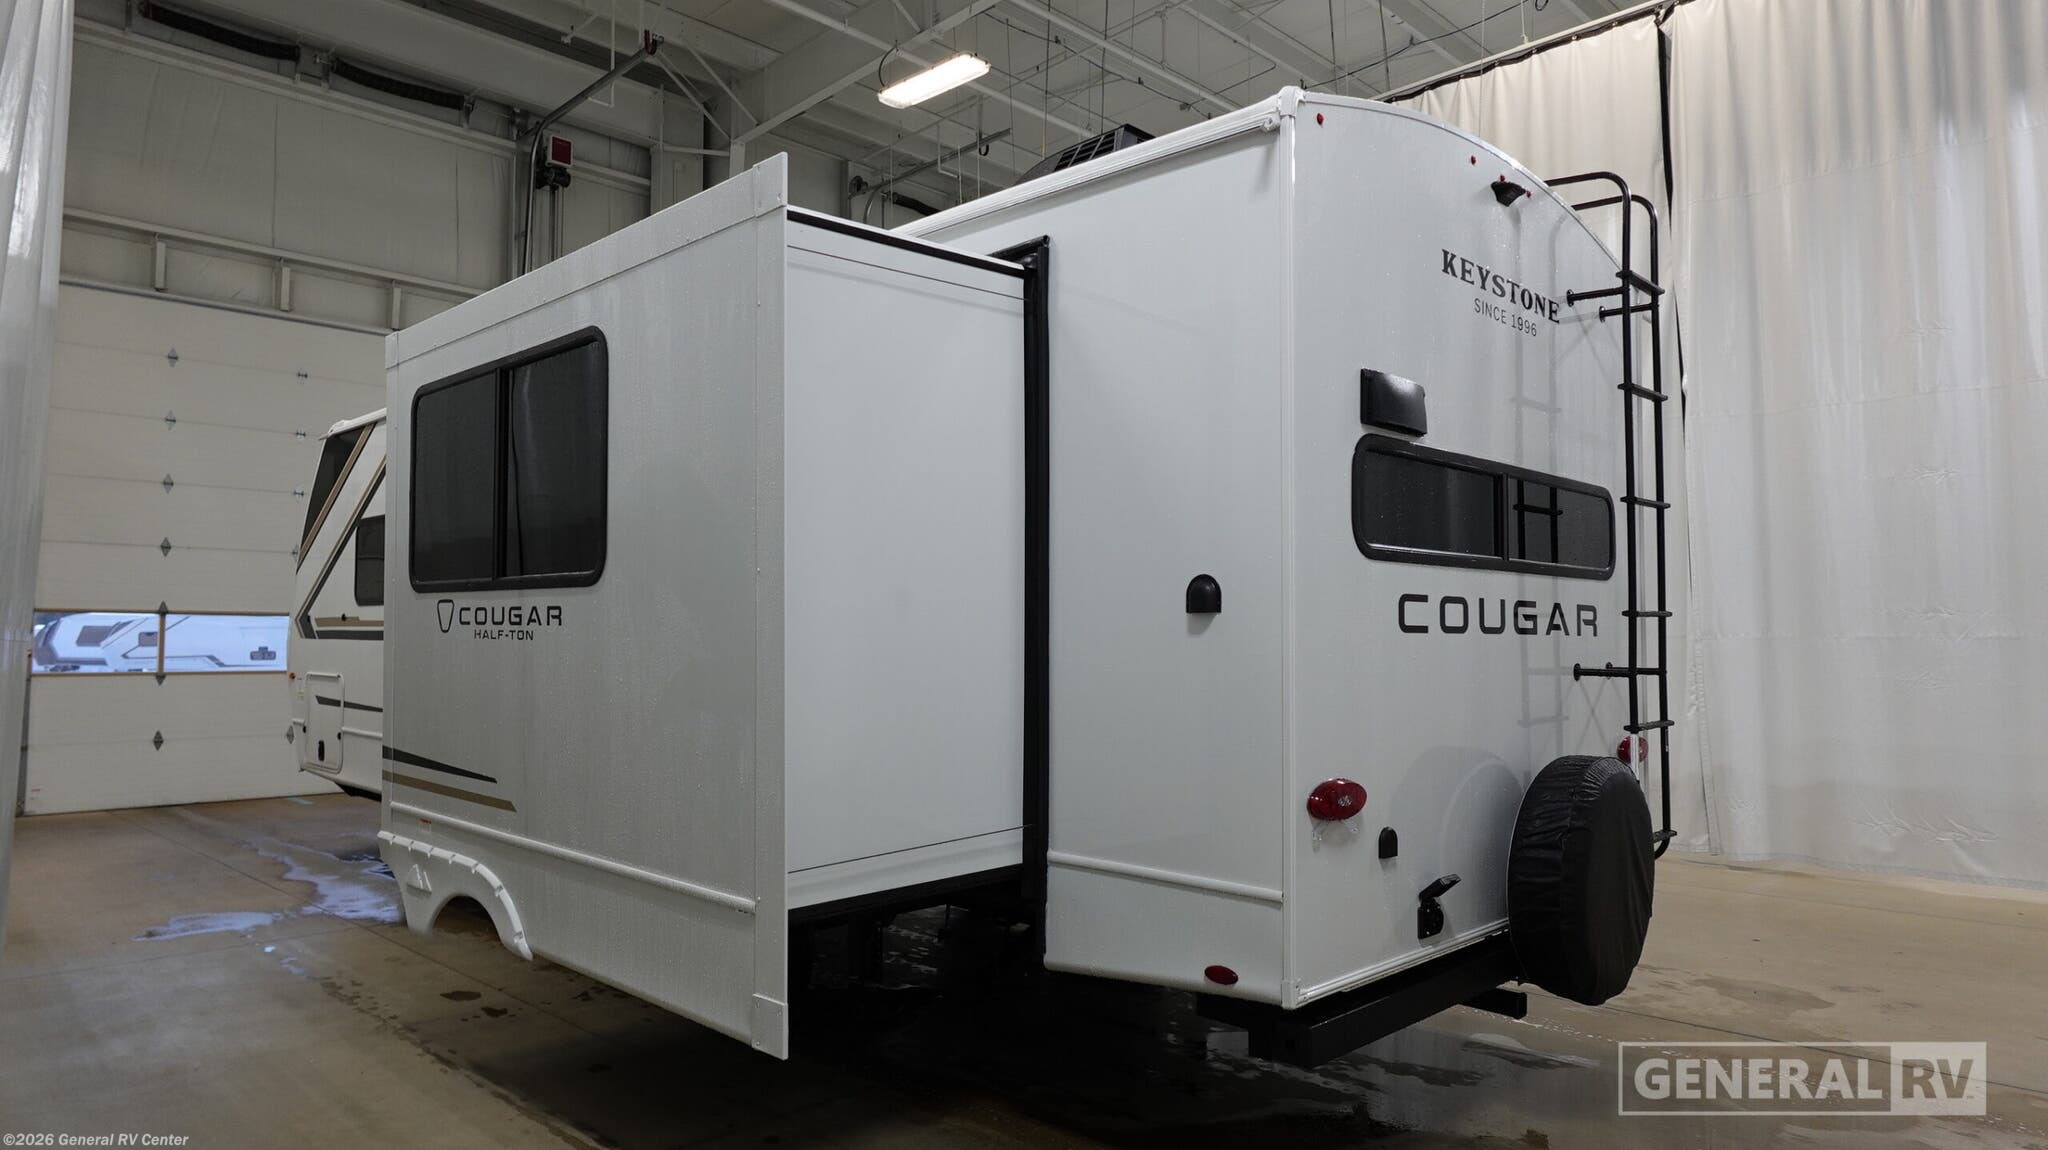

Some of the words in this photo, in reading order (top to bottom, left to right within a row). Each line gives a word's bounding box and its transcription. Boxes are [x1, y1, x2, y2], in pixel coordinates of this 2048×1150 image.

[1441, 249, 1560, 324] KEYSTONE
[1474, 298, 1507, 325] SINCE
[1511, 314, 1537, 337] 1996
[459, 606, 562, 626] COUGAR
[474, 629, 534, 640] HALF-TON
[1398, 593, 1598, 637] COUGAR
